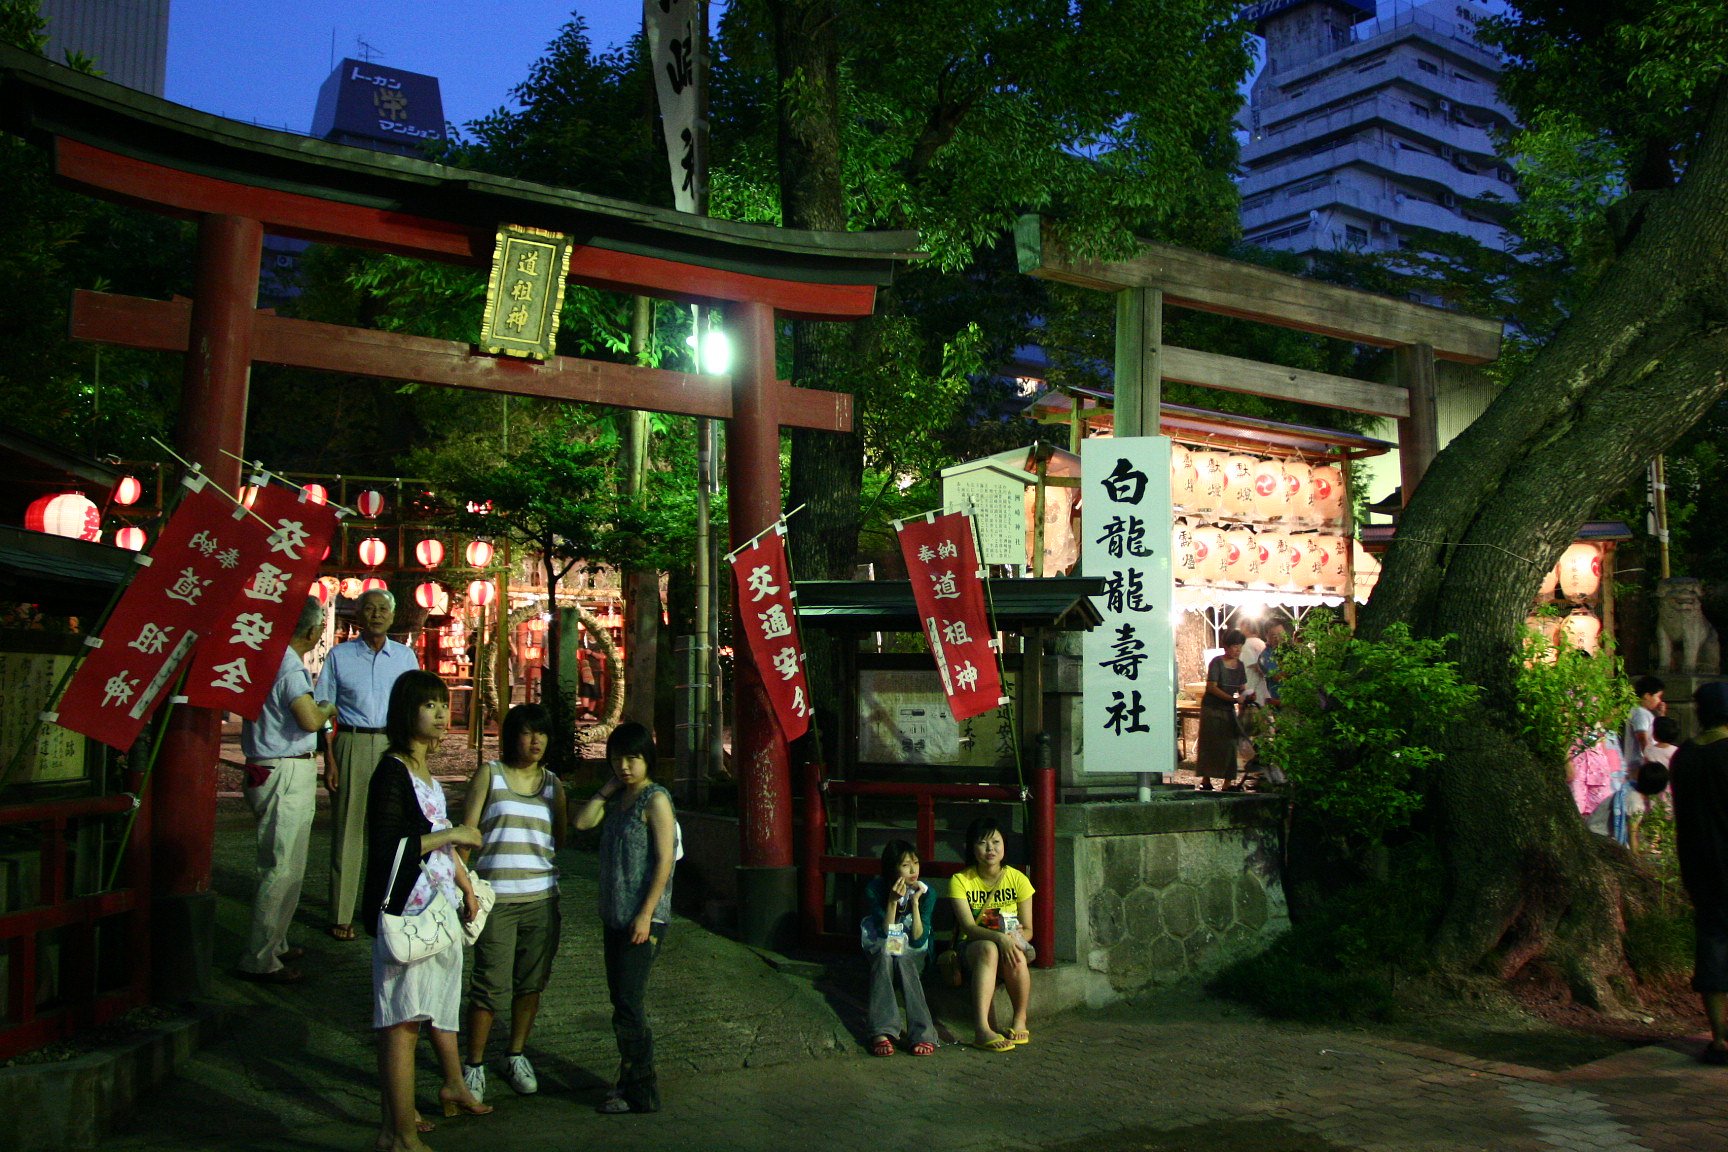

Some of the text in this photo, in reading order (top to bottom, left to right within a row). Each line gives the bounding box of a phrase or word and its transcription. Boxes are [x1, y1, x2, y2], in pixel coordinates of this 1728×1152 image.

[351, 66, 401, 89] トーカン
[373, 87, 407, 120] 栄
[378, 119, 440, 139] マンション
[506, 250, 538, 333] 道祖神
[917, 540, 958, 564] 奉納
[930, 570, 978, 692] 道祖神
